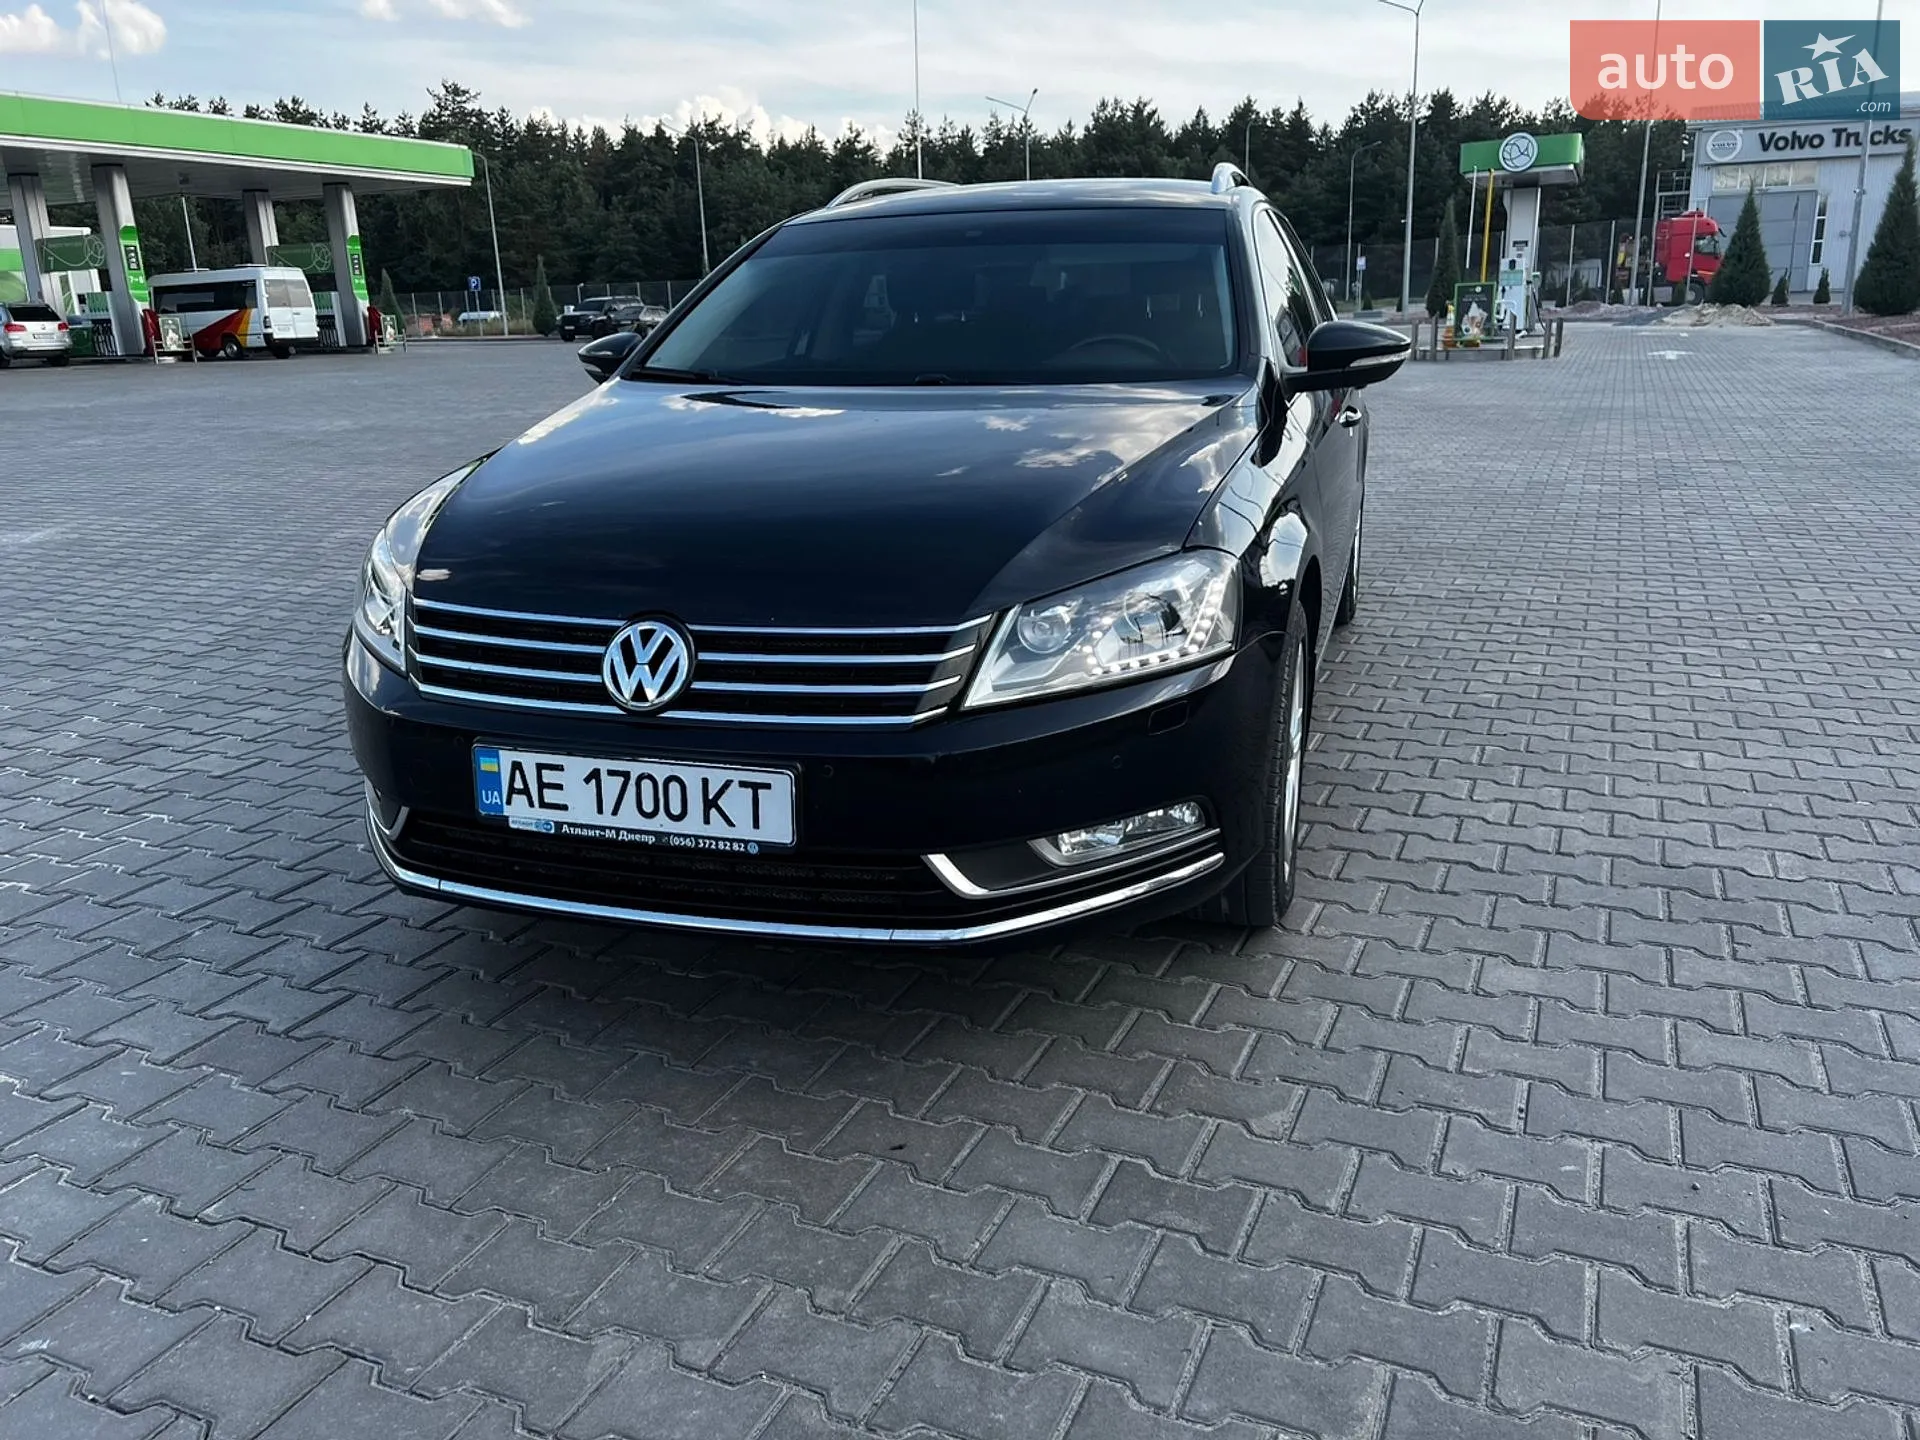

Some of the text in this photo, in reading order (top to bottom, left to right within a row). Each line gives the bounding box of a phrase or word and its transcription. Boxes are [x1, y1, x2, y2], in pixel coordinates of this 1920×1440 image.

[1758, 125, 1912, 152] Volvo Trucks
[482, 789, 502, 806] UA
[505, 760, 772, 830] AE 1700 KT
[618, 831, 656, 845] Днепр
[669, 834, 696, 848] (056)
[698, 839, 716, 850] 372
[717, 841, 731, 851] 82
[732, 842, 745, 852] 82
